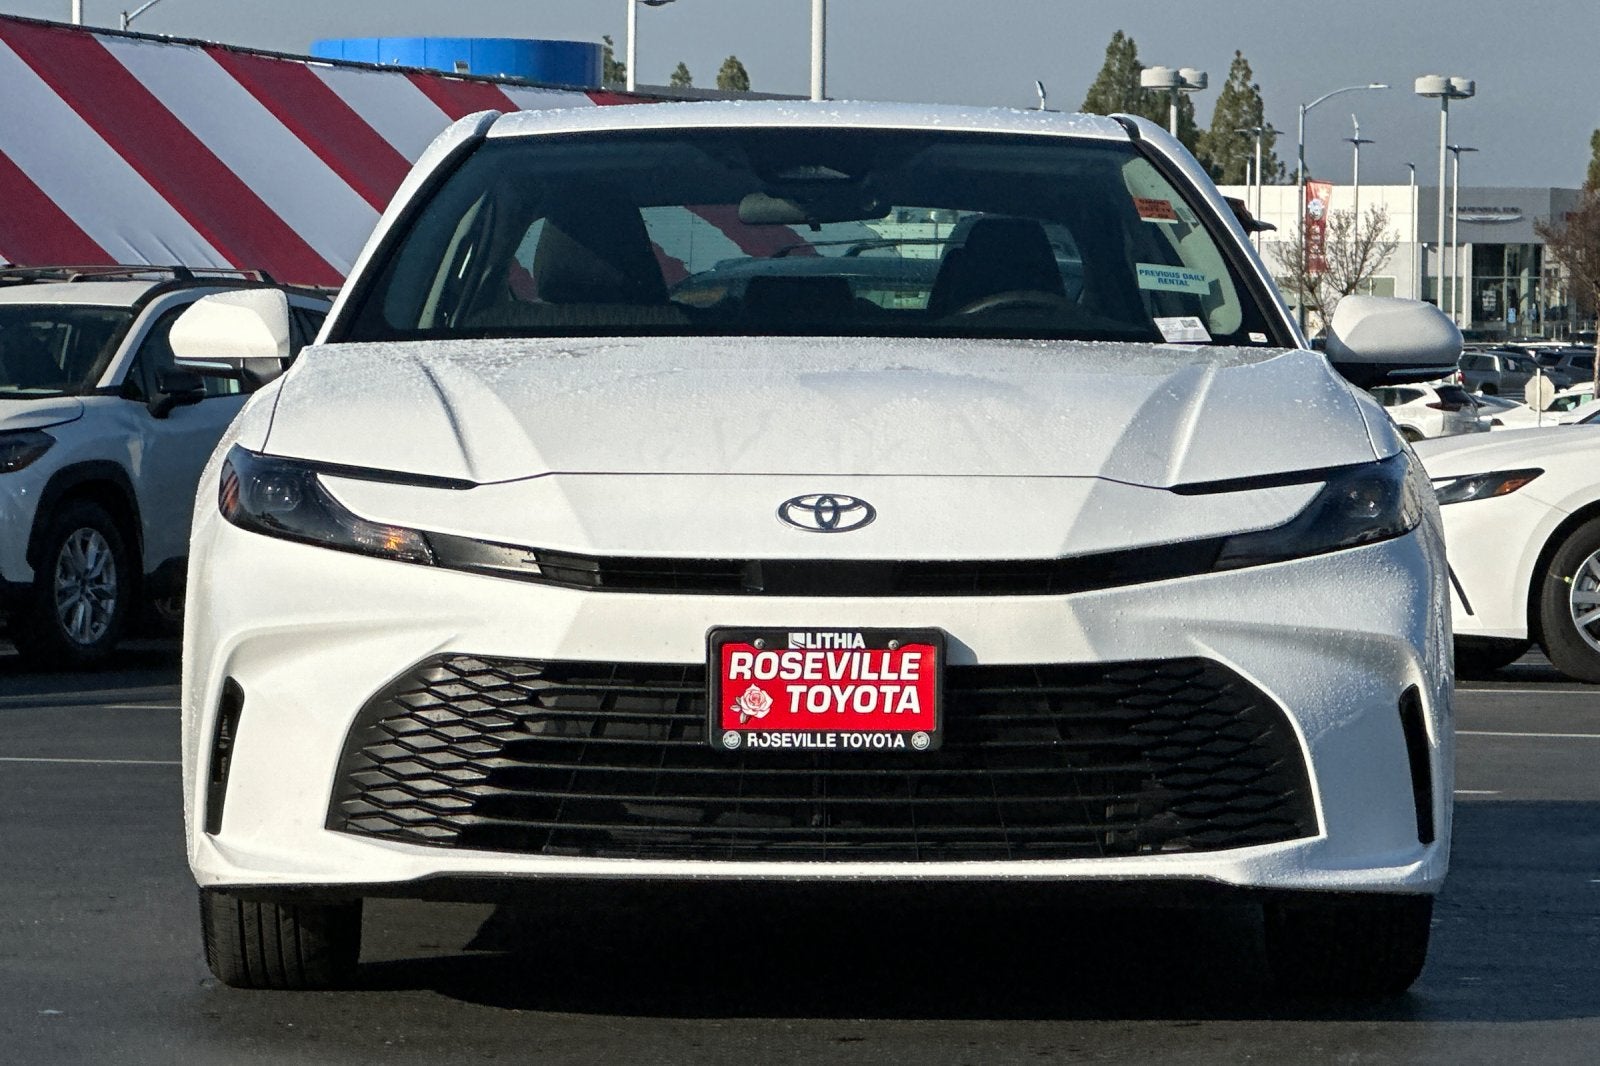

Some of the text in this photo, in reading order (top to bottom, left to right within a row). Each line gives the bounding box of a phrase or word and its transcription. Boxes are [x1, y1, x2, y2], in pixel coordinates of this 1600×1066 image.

[1139, 269, 1205, 281] PREVIOUS DAILY
[1157, 277, 1190, 286] RENTAL
[805, 633, 866, 649] LITHIA
[729, 651, 922, 680] ROSEVILLE
[786, 685, 921, 714] TOYOTA
